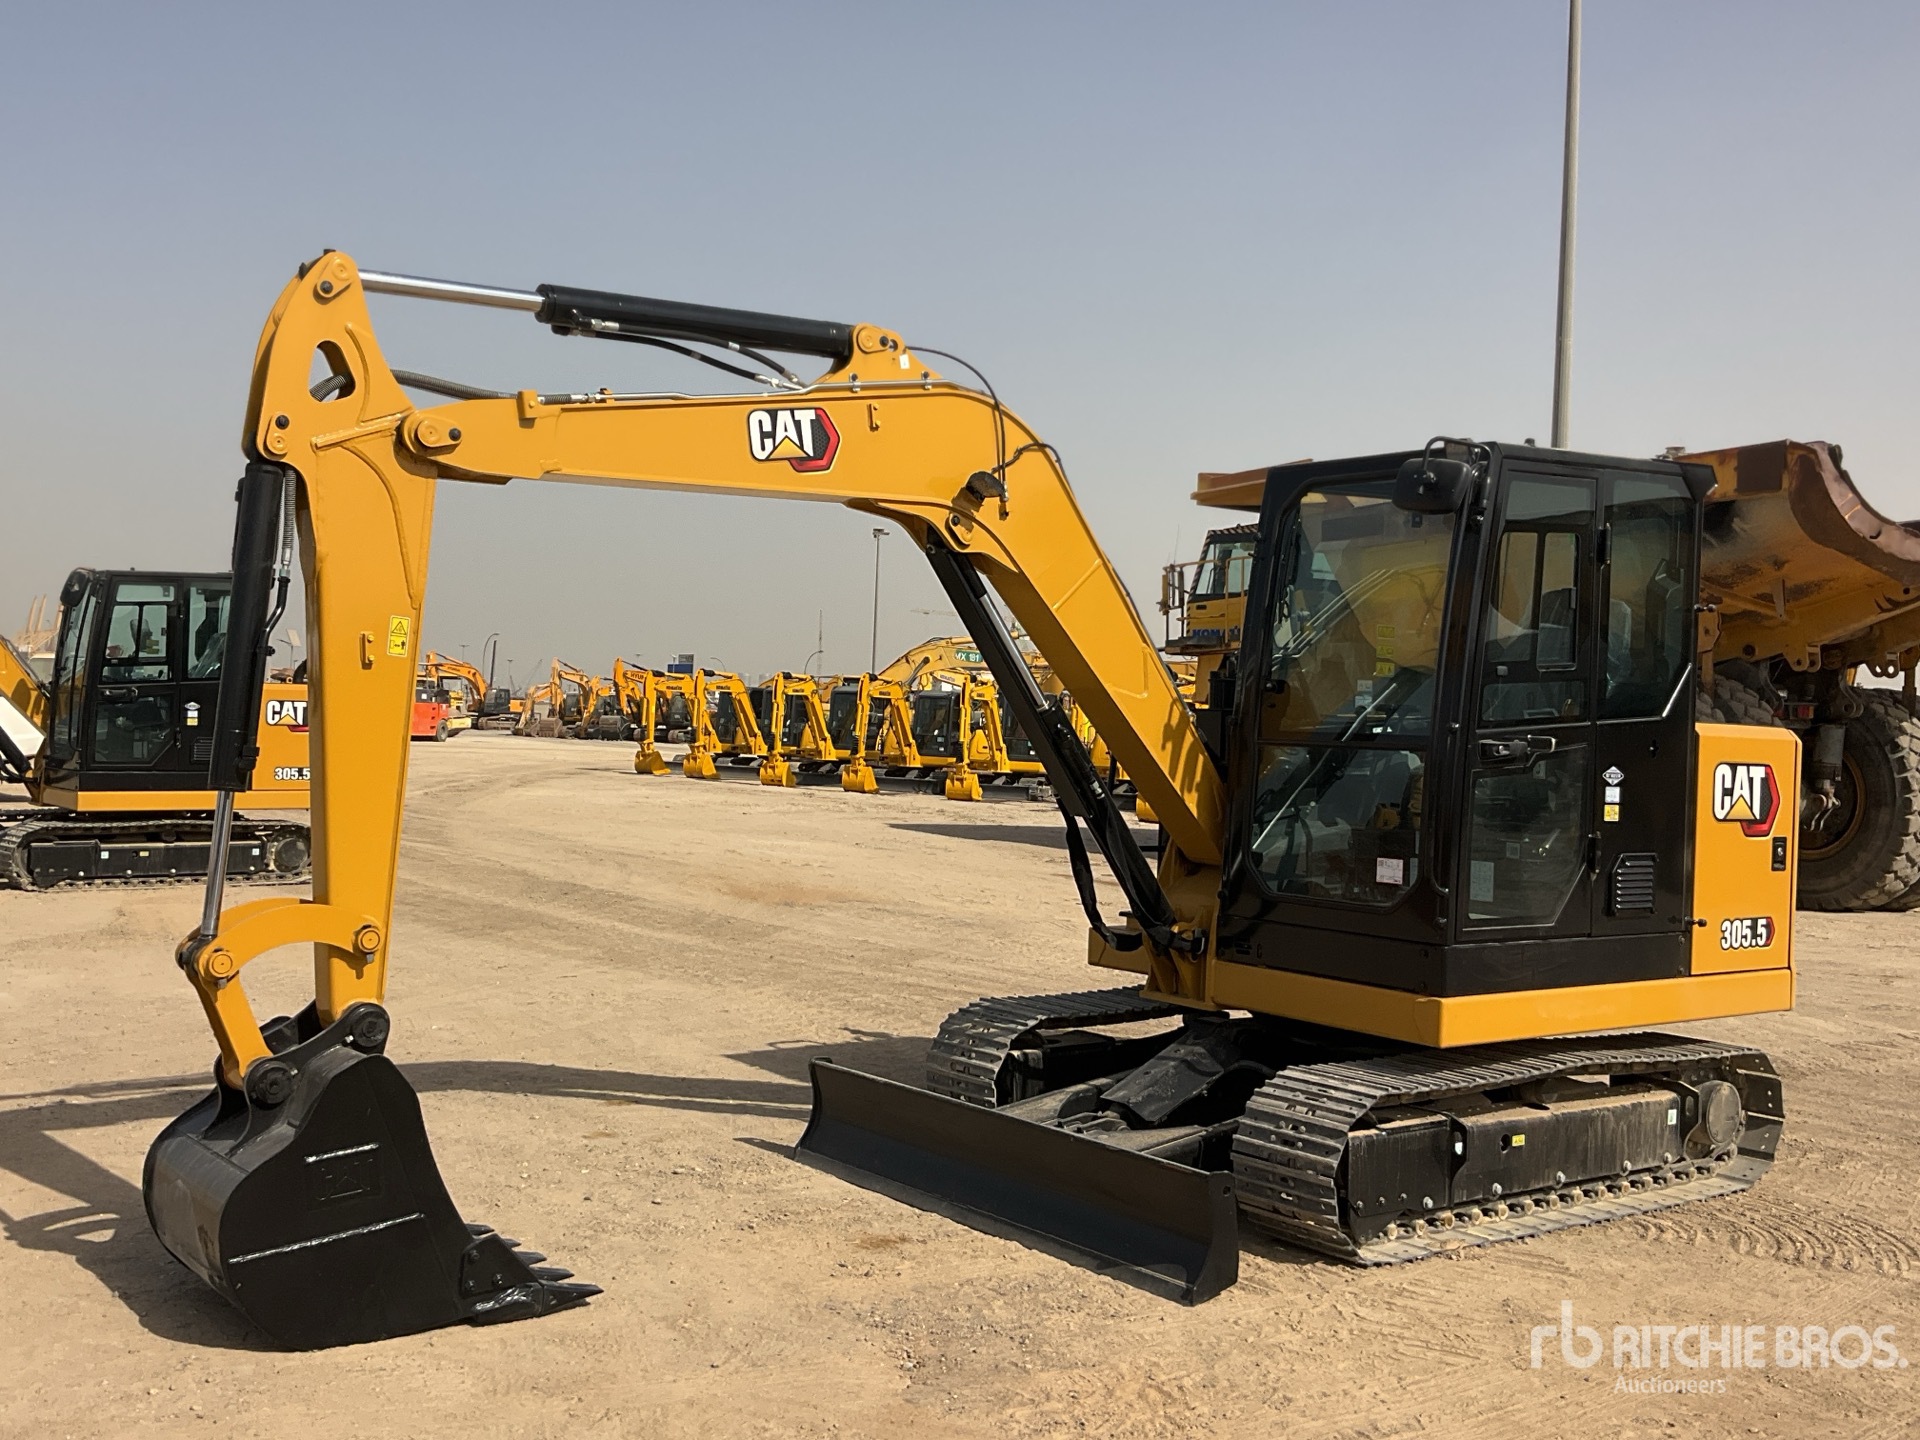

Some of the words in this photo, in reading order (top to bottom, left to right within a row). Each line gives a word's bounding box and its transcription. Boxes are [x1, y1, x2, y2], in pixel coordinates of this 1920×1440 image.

[749, 409, 816, 460] CAT
[266, 700, 307, 725] CAT
[274, 767, 310, 780] 305.5
[1714, 764, 1766, 820] CAT
[1721, 918, 1767, 949] 305.5
